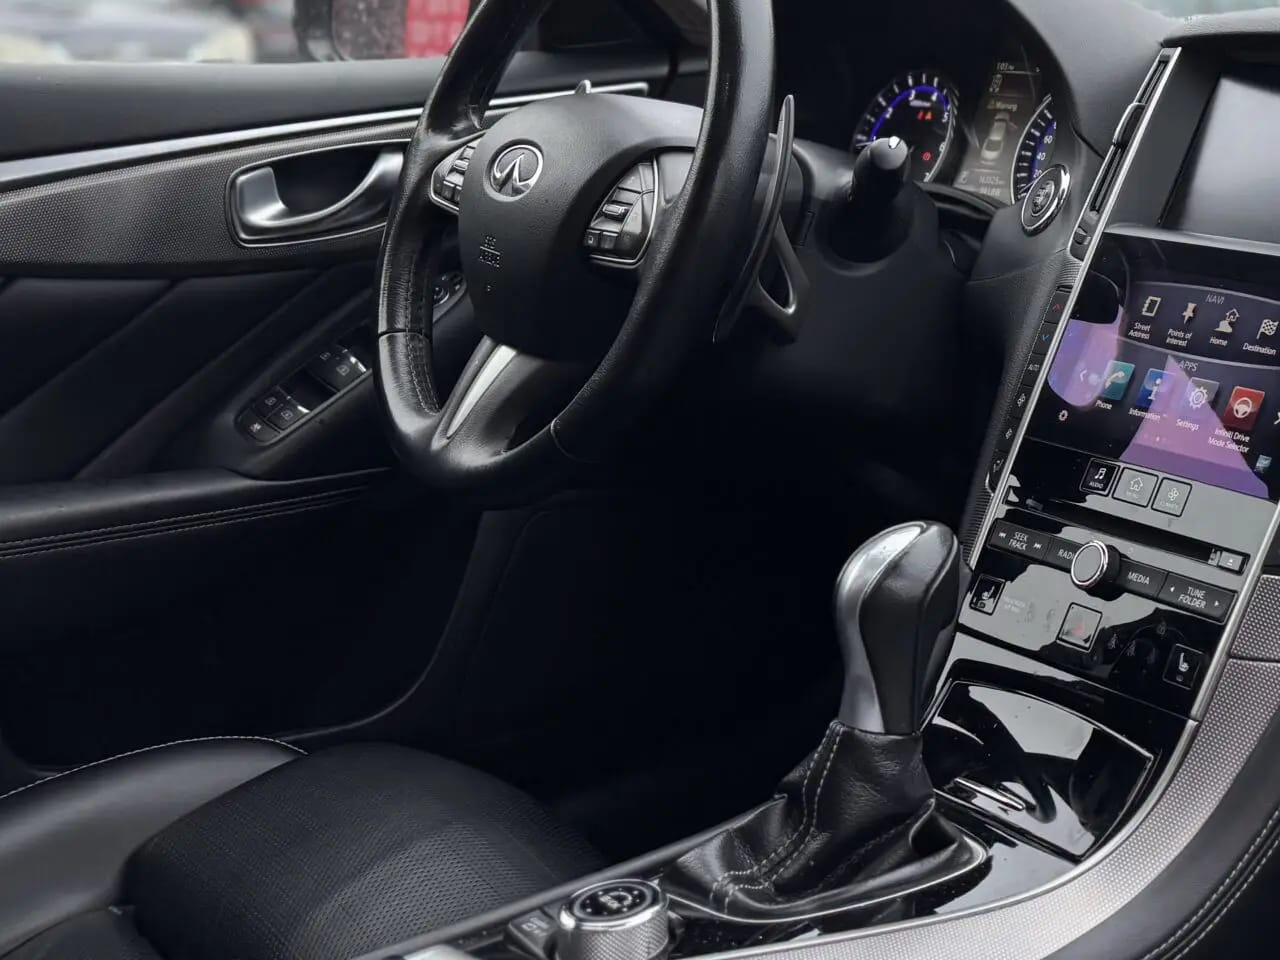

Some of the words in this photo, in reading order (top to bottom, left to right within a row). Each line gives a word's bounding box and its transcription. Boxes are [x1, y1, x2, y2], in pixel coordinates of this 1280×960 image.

[909, 90, 916, 101] 3
[942, 112, 949, 122] 5
[1043, 135, 1053, 144] 60
[1036, 152, 1046, 161] 40
[1205, 294, 1225, 305] NAVI
[1134, 322, 1151, 332] Street
[1128, 330, 1150, 340] Address
[1168, 328, 1185, 339] Points
[1185, 332, 1192, 340] of
[1166, 337, 1188, 347] Interest
[1210, 336, 1228, 347] Home
[1242, 342, 1276, 356] Destination
[1179, 360, 1199, 372] APPS
[1096, 400, 1113, 411] Phone
[1129, 408, 1161, 422] Information
[1176, 419, 1200, 432] Settings
[1215, 427, 1233, 439] Infiniti
[1234, 431, 1250, 443] Drive
[1208, 437, 1225, 448] Mode
[1226, 441, 1250, 453] Selector
[1089, 481, 1104, 489] AUDIO
[1013, 531, 1029, 541] SEEK
[1009, 539, 1028, 551] TRACK
[1058, 549, 1075, 560] RADI
[1128, 571, 1150, 585] MEDIA
[1187, 586, 1206, 599] TUNE
[1178, 595, 1207, 609] FOLDER
